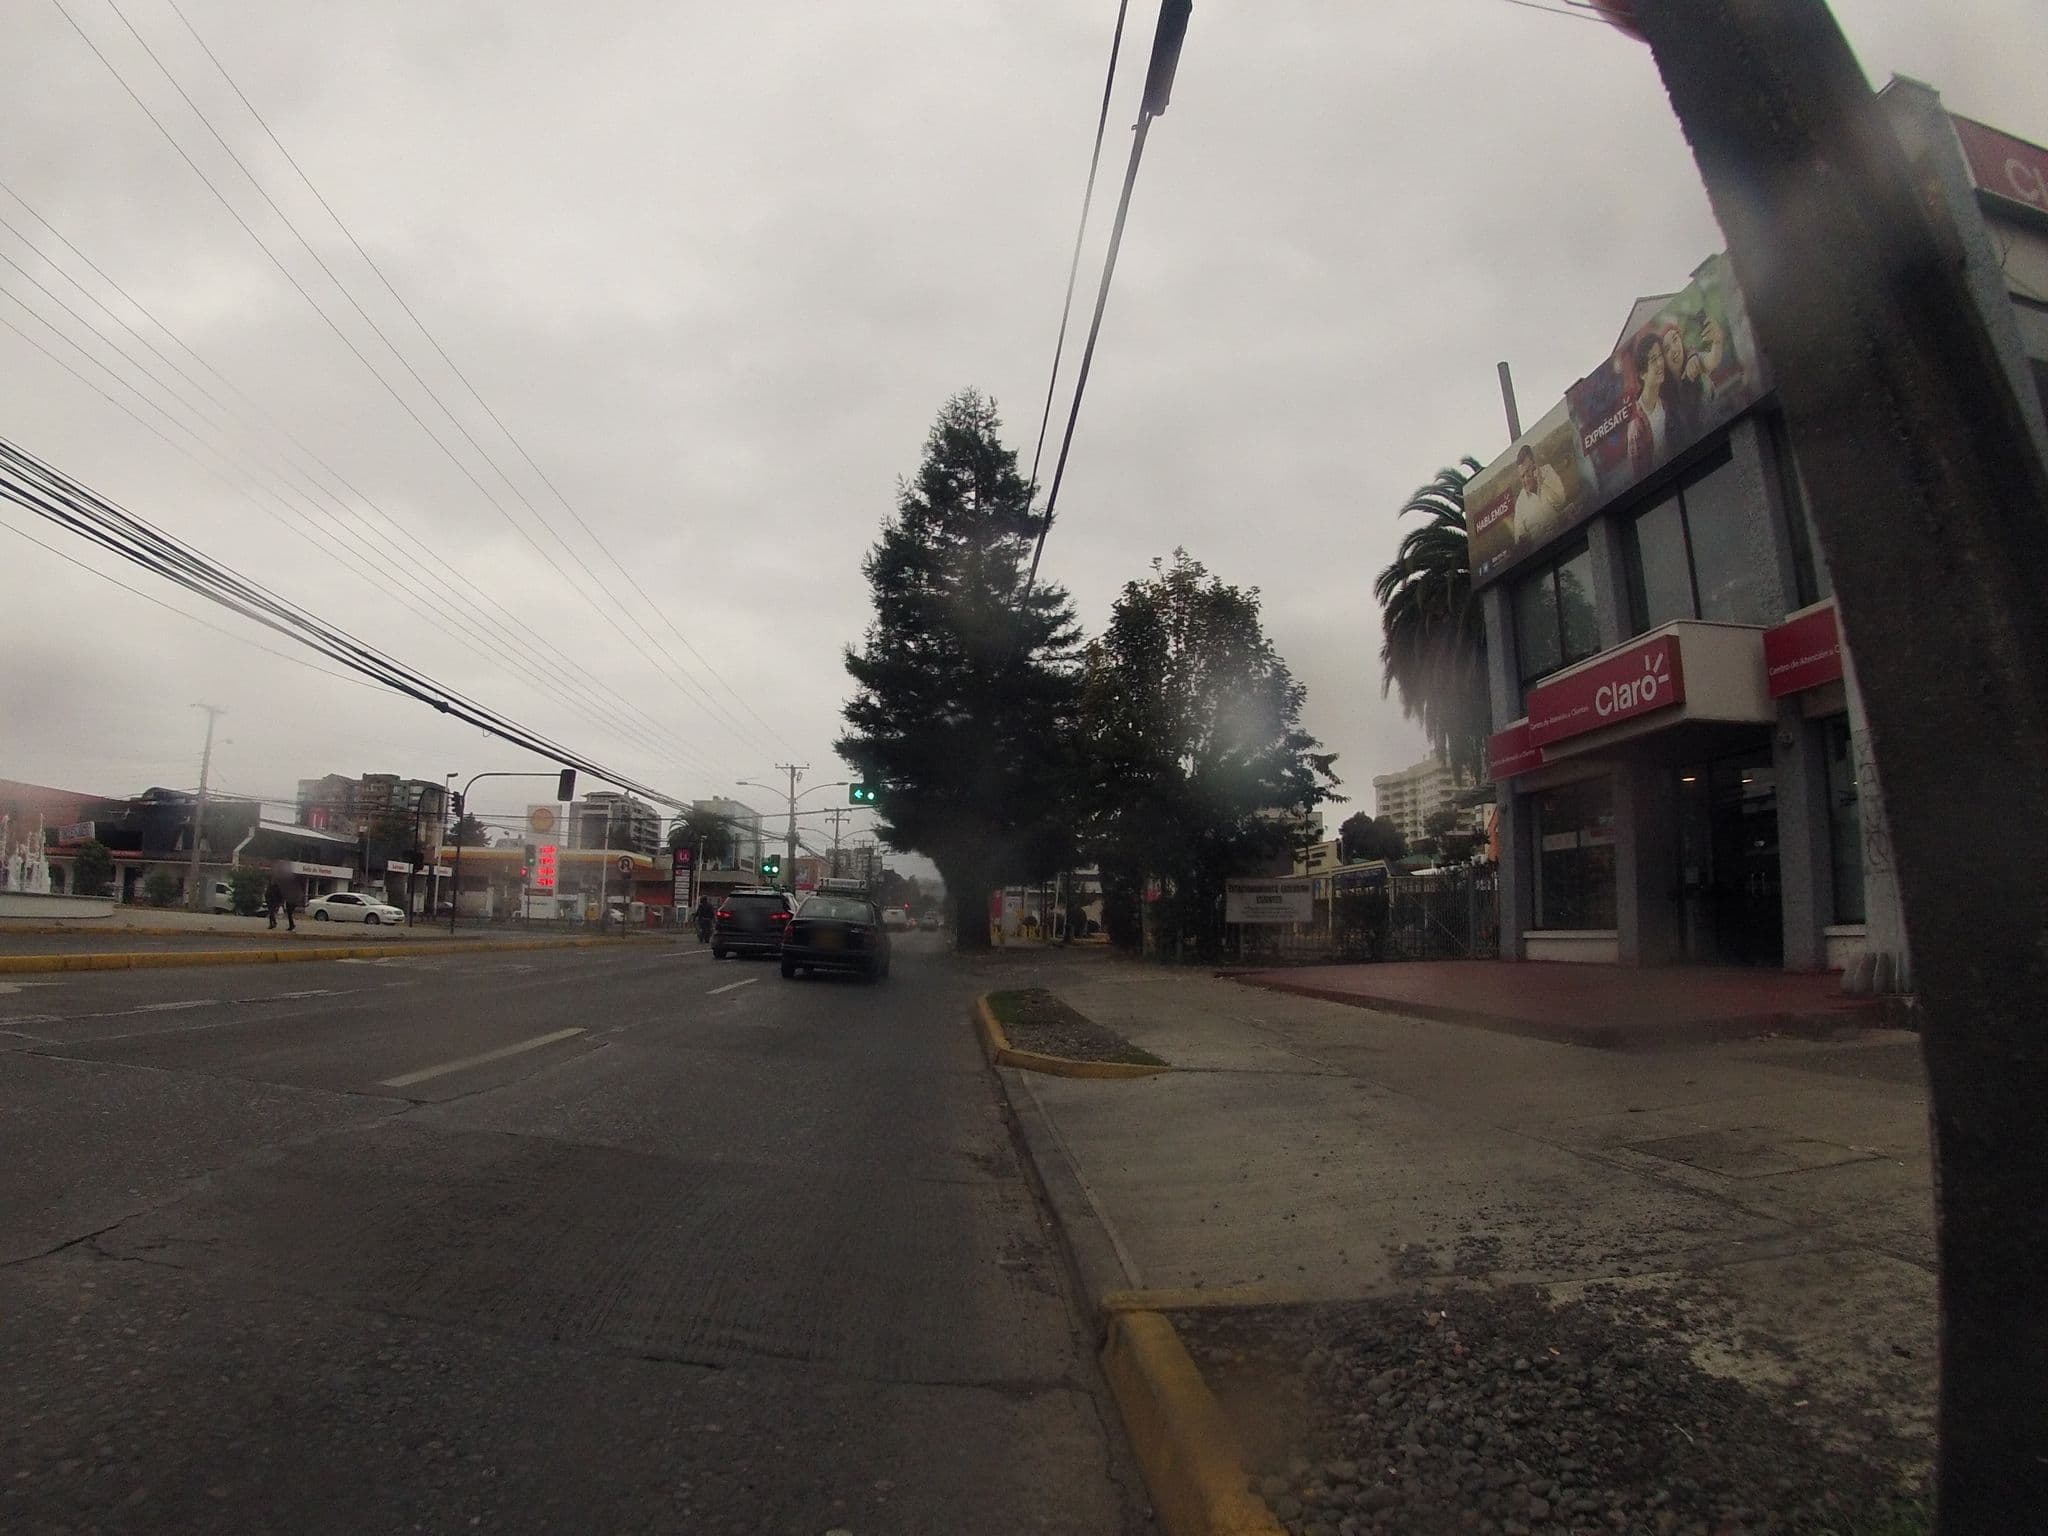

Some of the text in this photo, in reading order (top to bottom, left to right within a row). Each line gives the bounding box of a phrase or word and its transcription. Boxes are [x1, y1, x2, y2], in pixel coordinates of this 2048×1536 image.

[1584, 406, 1629, 449] EXPRÉSATE
[1476, 502, 1509, 532] HABLEMOS
[1595, 667, 1660, 717] Claro
